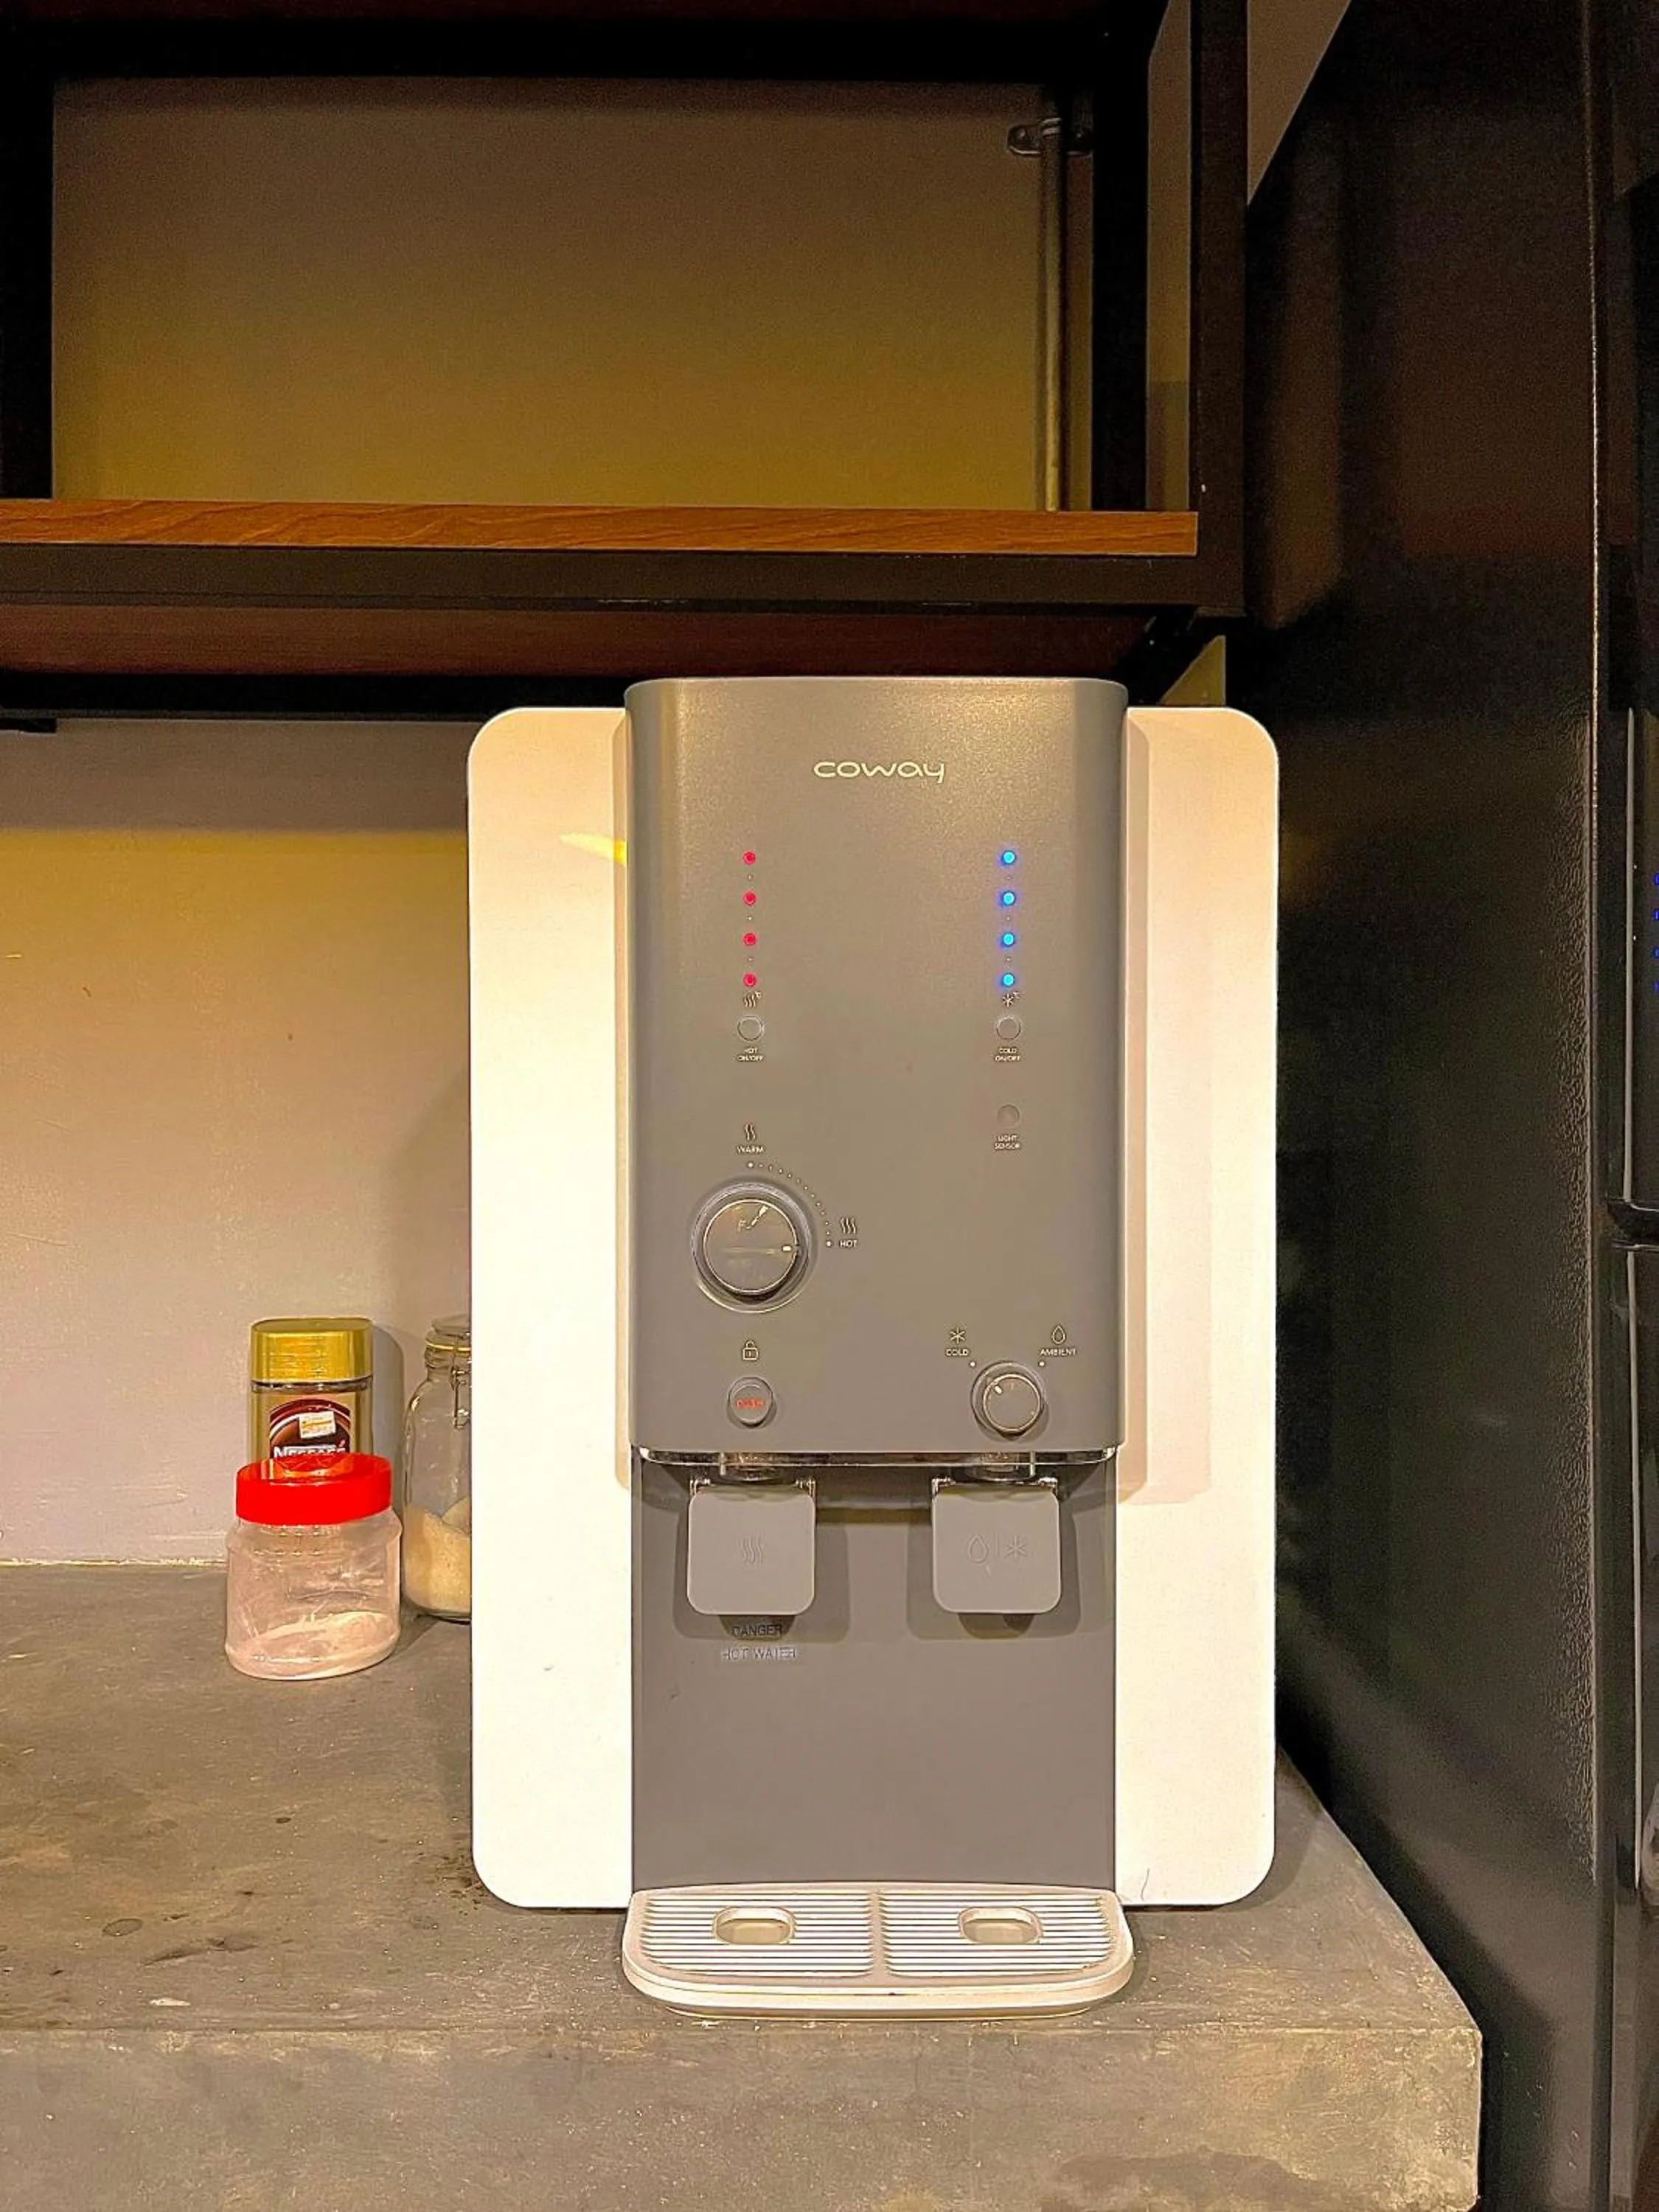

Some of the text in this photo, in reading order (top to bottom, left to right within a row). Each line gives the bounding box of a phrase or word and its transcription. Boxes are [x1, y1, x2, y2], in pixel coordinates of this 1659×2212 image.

[813, 761, 945, 784] coway
[737, 1145, 765, 1154] WARM
[840, 1239, 858, 1248] HOT
[946, 1348, 970, 1357] COLD
[1039, 1348, 1077, 1357] AMBIENT
[731, 1624, 782, 1638] DANGER
